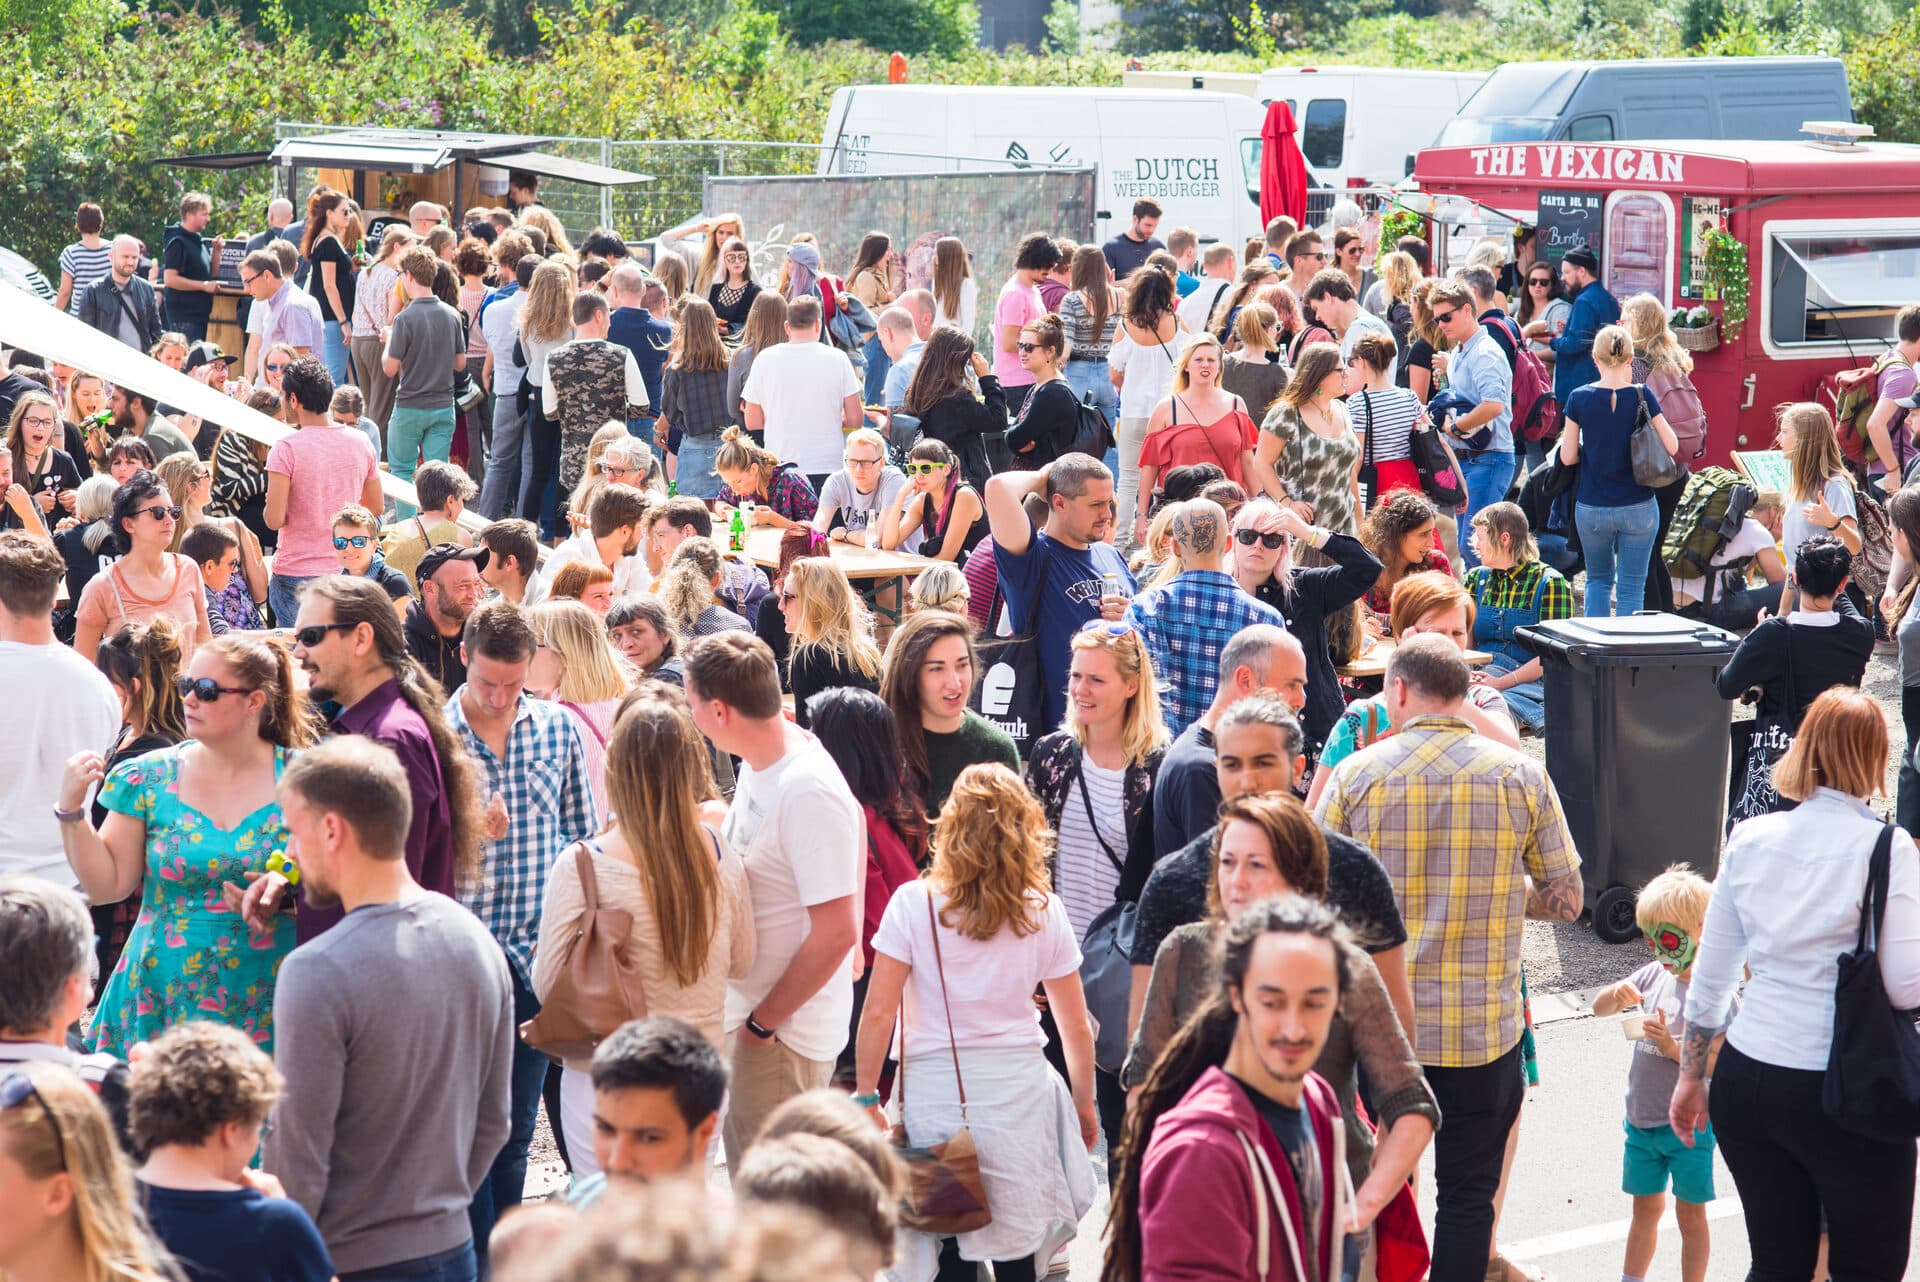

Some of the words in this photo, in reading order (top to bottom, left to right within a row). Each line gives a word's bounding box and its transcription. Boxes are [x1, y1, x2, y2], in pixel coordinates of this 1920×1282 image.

[1112, 170, 1133, 181] THE
[1135, 158, 1219, 180] DUTCH
[1470, 146, 1527, 176] THE
[1537, 146, 1684, 182] VEXICAN
[1113, 182, 1220, 197] WEEDBURGER
[1541, 195, 1566, 207] CARTA
[1570, 196, 1582, 207] DEL
